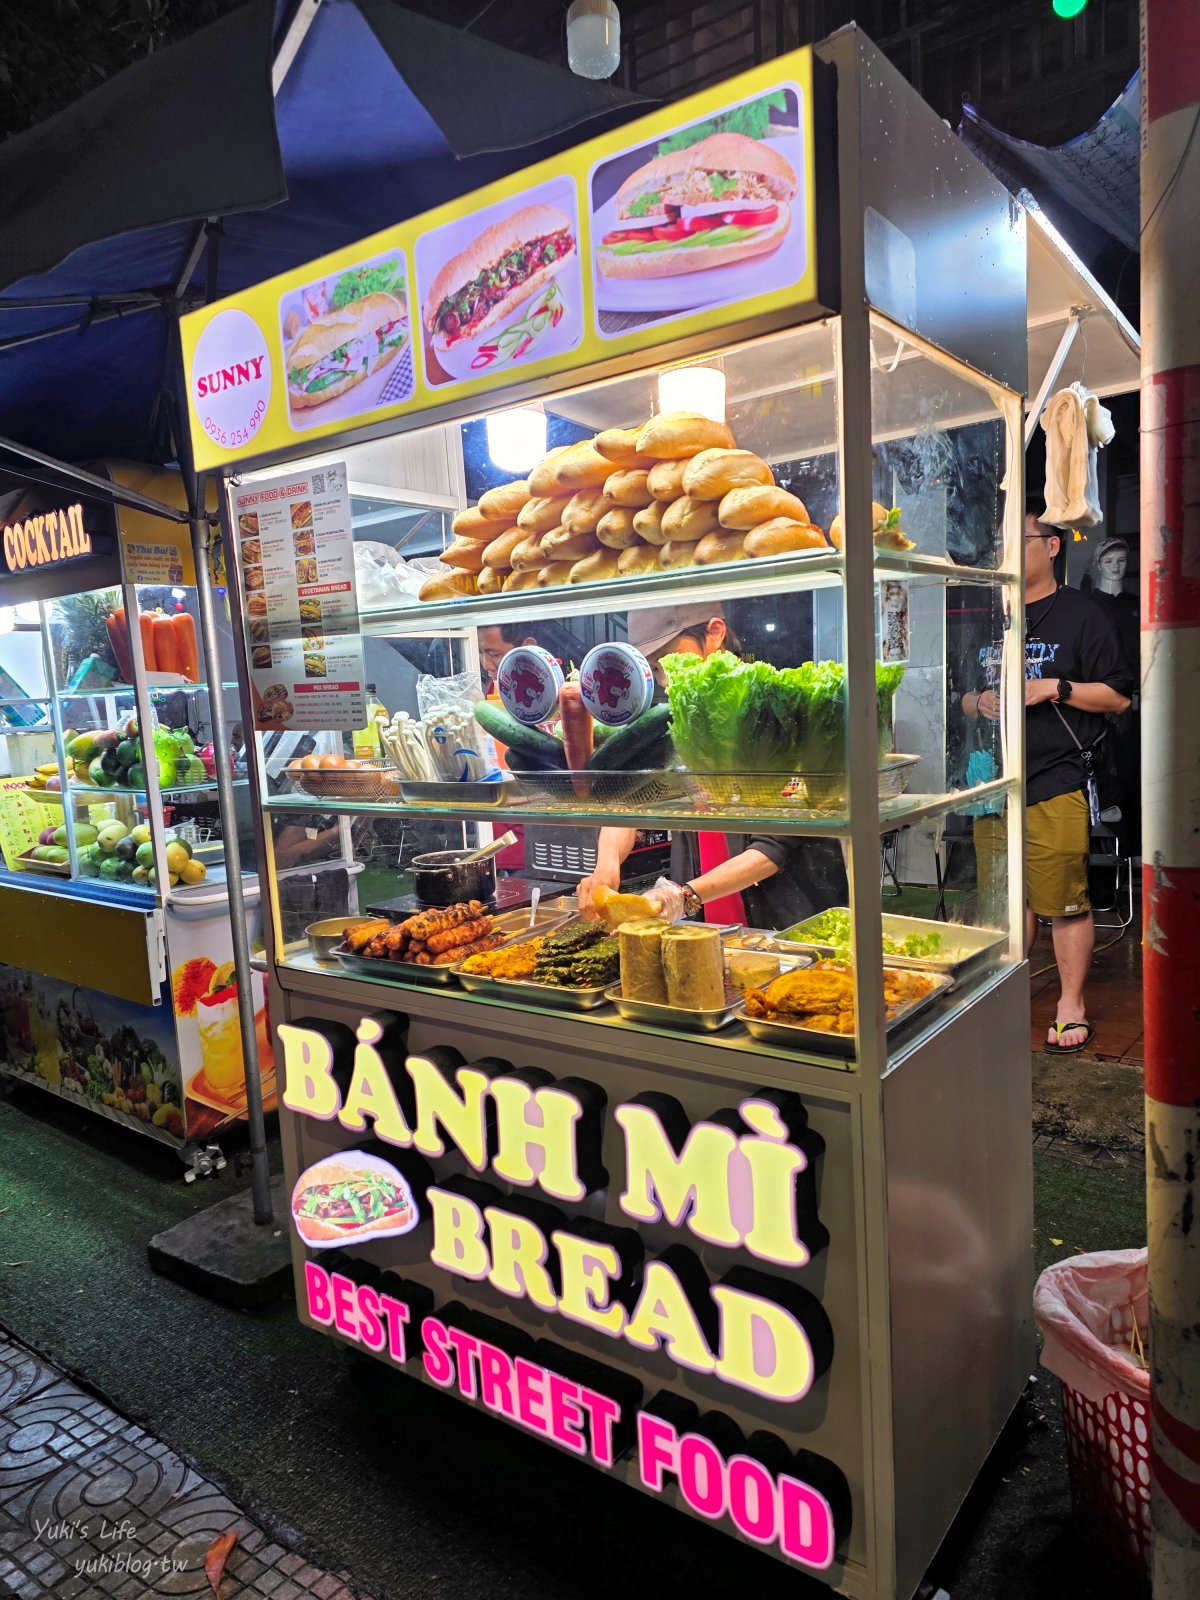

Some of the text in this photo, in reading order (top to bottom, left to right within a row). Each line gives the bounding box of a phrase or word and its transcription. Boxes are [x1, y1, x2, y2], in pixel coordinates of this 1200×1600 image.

[197, 355, 264, 398] SUNNY
[204, 400, 266, 445] 0936 254 990
[237, 482, 308, 507] SUNNY FOOD & DRINK
[3, 503, 92, 572] COCKTAIL
[301, 583, 347, 594] VEGETARIAN BREAD
[277, 1017, 810, 1268] BÁNH MÌ
[426, 1186, 815, 1402] BREAD
[304, 1260, 835, 1569] BEST STREET FOOD
